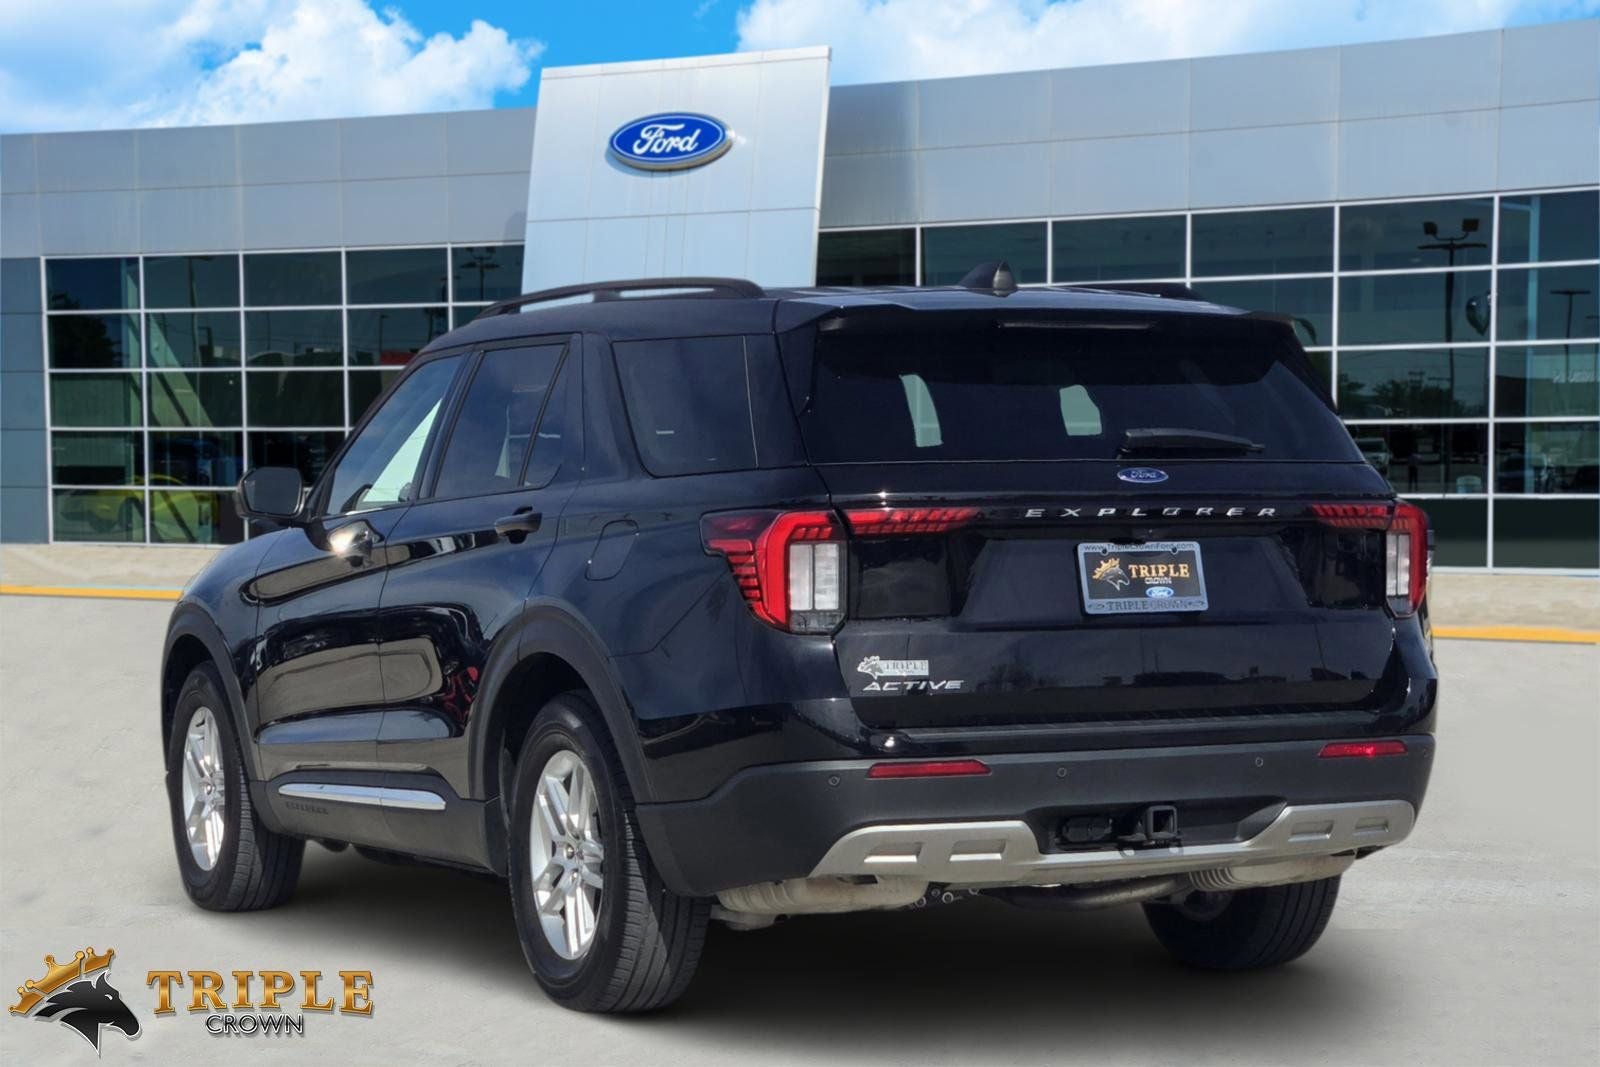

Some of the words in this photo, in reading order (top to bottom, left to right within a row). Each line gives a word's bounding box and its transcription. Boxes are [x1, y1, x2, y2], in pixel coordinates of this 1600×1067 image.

[632, 124, 702, 155] Ford
[1025, 507, 1277, 517] EXPLORER
[1128, 564, 1190, 578] TRIPLE
[1105, 600, 1149, 611] TRIPLE
[863, 680, 964, 691] ACTIVE
